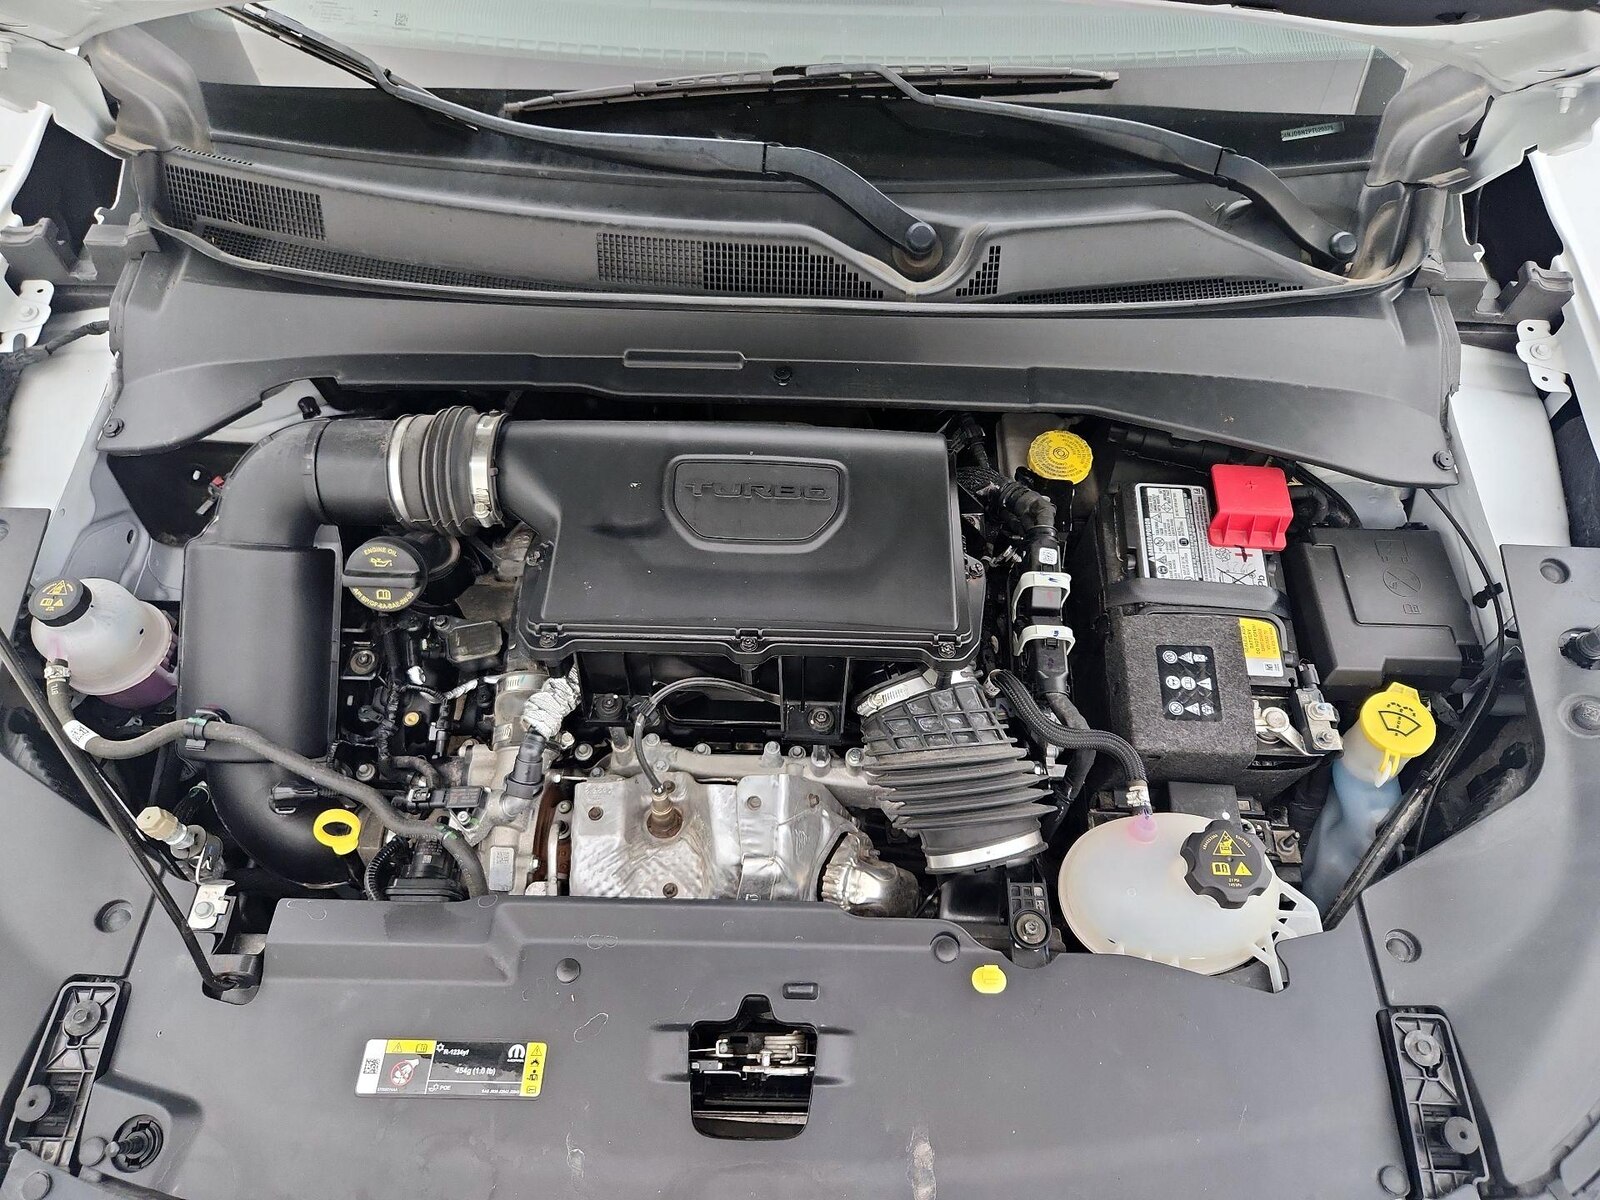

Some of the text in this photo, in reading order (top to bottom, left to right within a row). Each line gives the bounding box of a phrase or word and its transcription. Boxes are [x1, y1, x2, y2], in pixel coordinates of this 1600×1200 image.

[685, 483, 831, 500] TURBO
[363, 546, 398, 557] ENGINE OIL
[443, 1048, 469, 1056] R-1234yf
[455, 1067, 472, 1076] 454g
